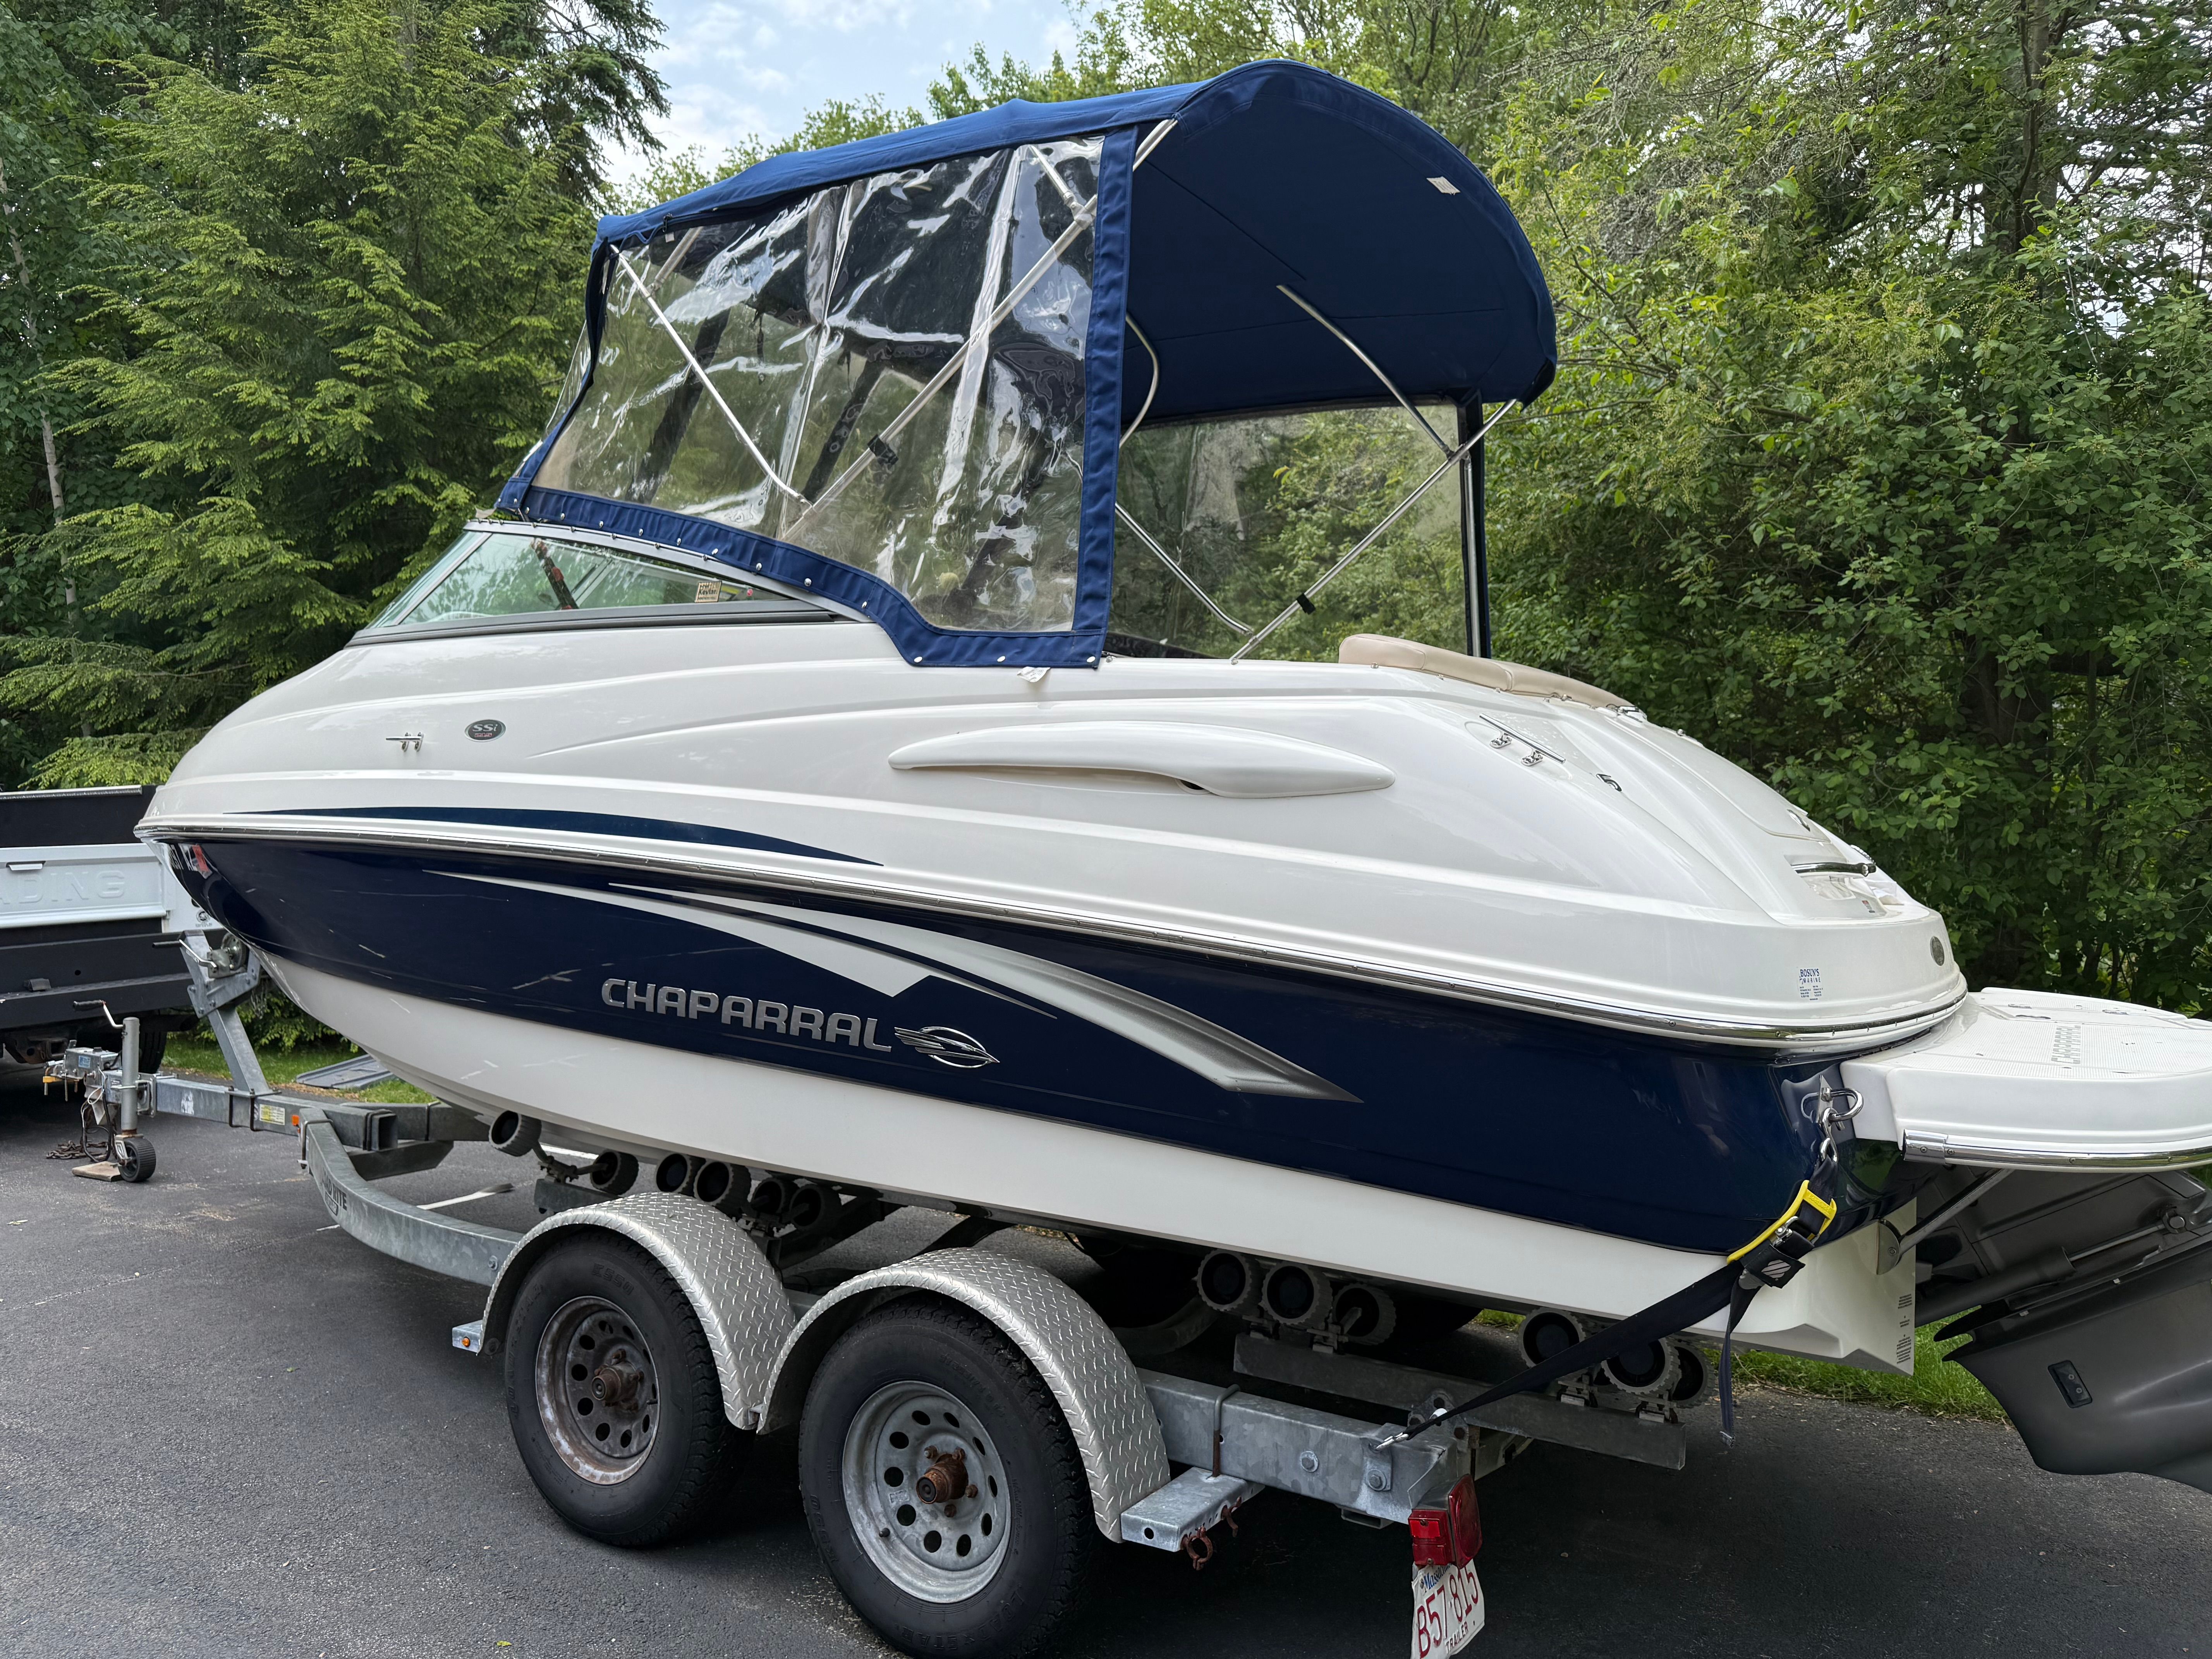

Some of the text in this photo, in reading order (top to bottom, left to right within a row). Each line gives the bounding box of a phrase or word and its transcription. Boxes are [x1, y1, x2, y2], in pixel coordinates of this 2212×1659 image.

[1800, 969, 1819, 977] BOSUN'S
[601, 978, 891, 1053] CHAPARRAL
[2051, 1025, 2081, 1064] CHAPARRAL
[332, 1183, 347, 1211] RITE
[592, 1263, 634, 1295] K550
[1417, 1566, 1478, 1659] B57 815
[1446, 1621, 1468, 1652] TRAILER
